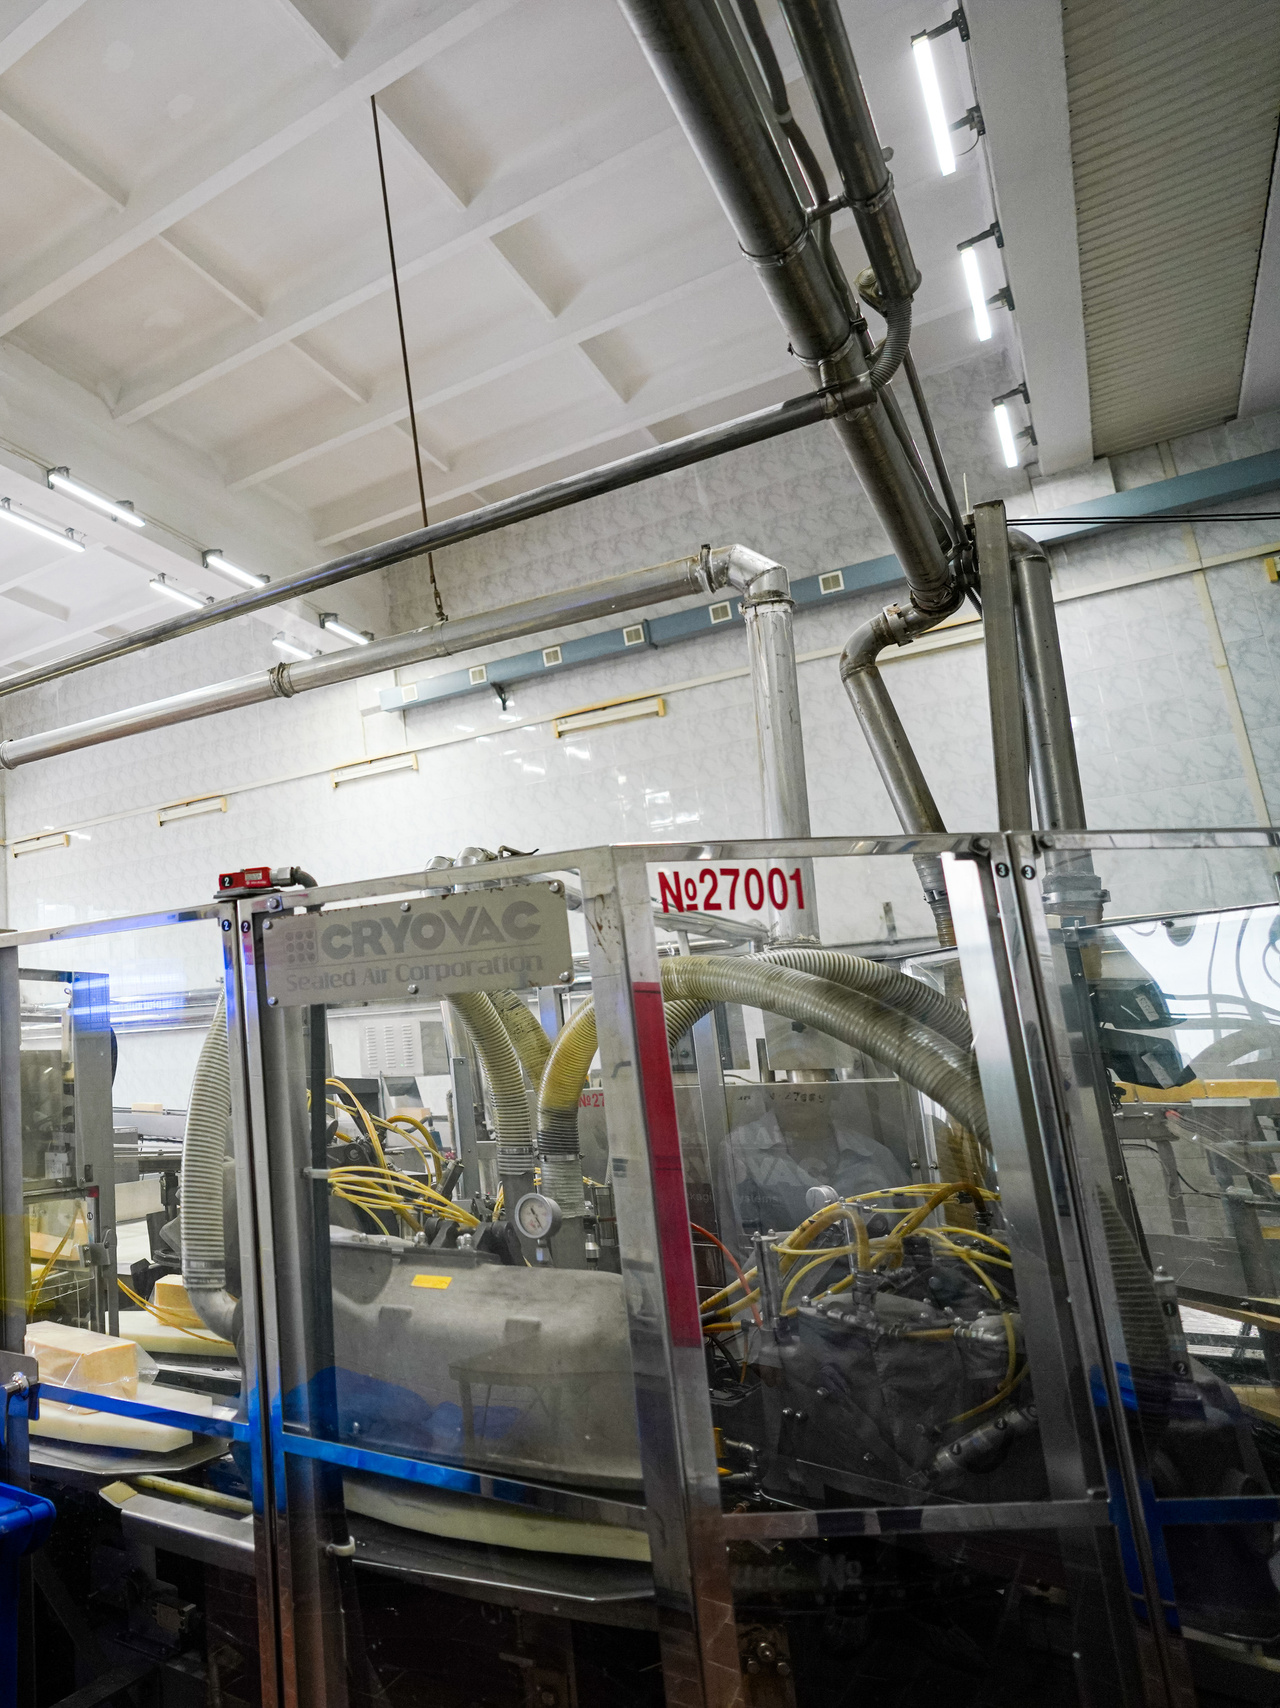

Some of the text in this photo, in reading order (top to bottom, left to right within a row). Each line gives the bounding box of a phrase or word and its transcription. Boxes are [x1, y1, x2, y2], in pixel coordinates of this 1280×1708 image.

[657, 867, 805, 913] №27001
[321, 900, 540, 959] CRYOVAC
[286, 953, 544, 991] Sealed Air Corporation
